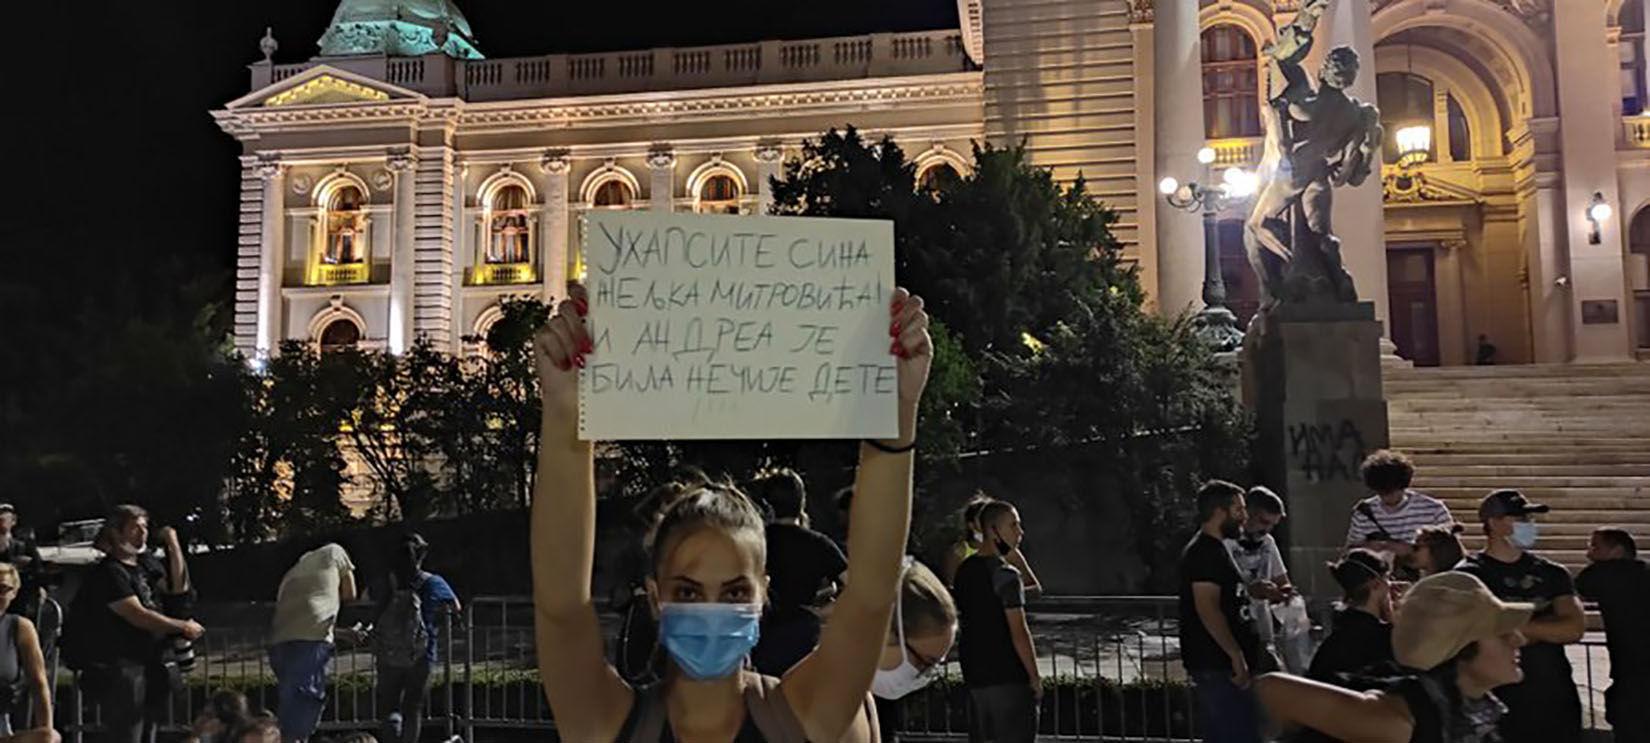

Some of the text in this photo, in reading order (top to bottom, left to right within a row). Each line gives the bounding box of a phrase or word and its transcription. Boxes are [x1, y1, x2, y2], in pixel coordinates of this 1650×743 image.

[597, 221, 873, 275] УХАПСИТЕ СИНА
[631, 316, 774, 363] АНДРЕА
[789, 323, 840, 354] ЈЕ
[591, 362, 674, 394] БИЛА
[808, 361, 897, 404] ДЕТЕ
[1288, 418, 1361, 457] ИМА
